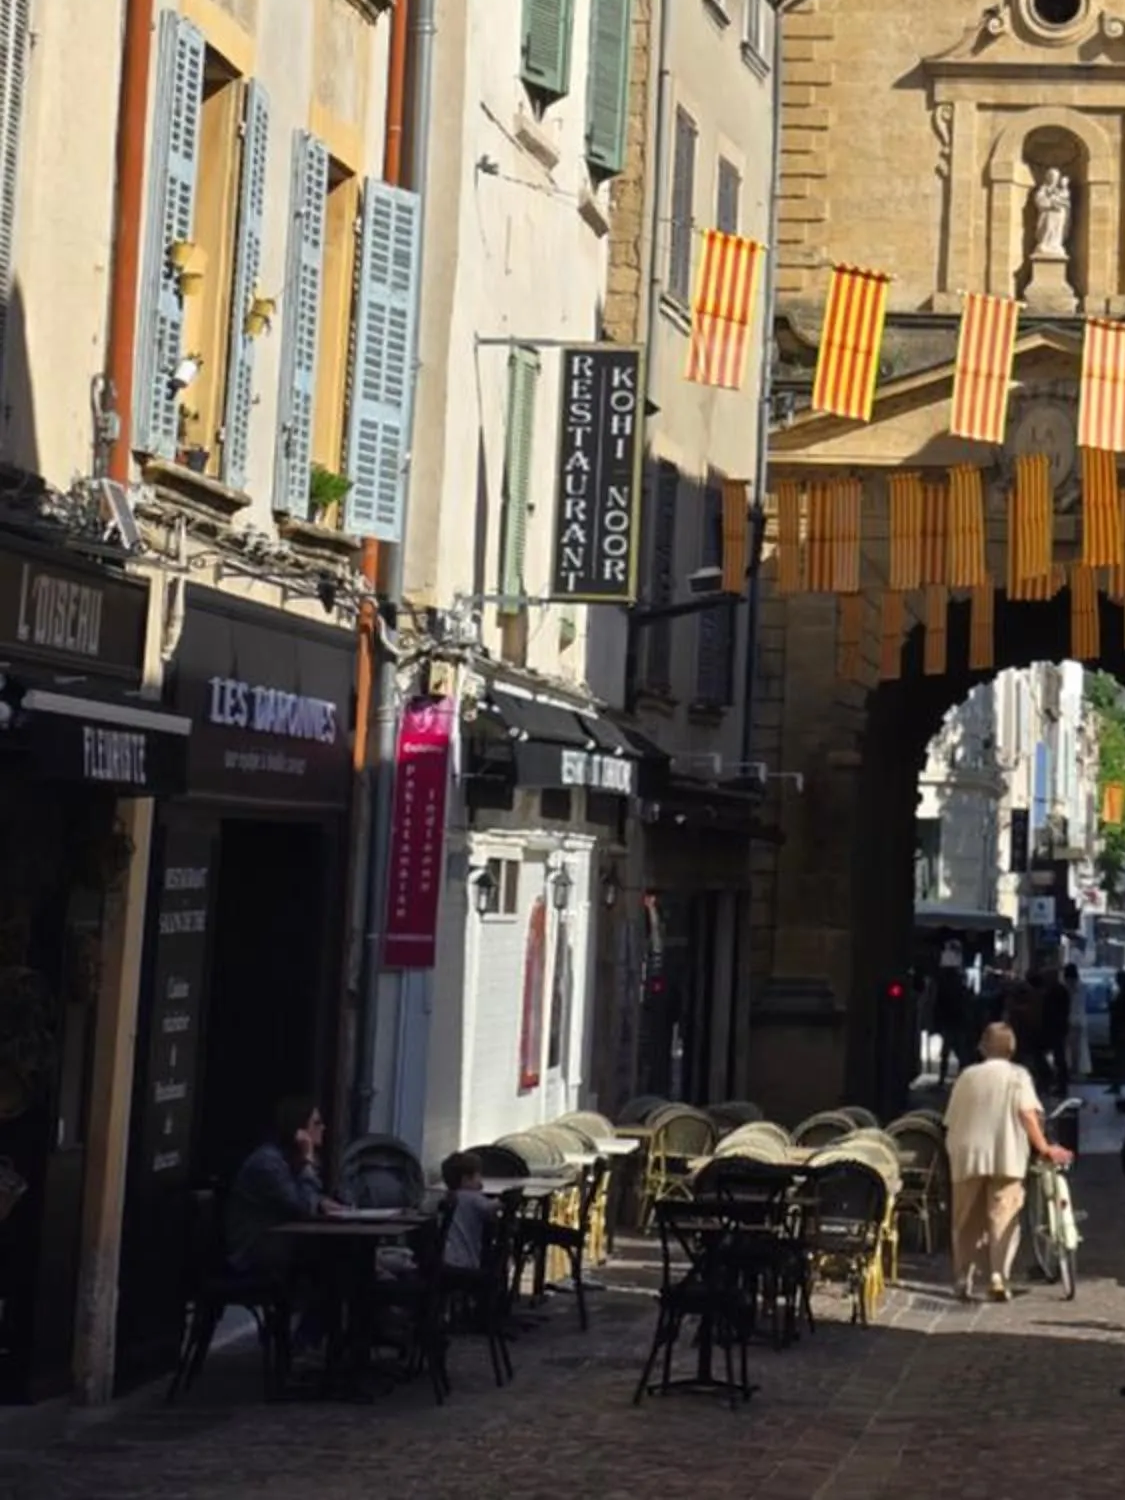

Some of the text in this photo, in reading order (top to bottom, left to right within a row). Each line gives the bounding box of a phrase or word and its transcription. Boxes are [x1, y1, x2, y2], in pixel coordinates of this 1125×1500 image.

[560, 355, 593, 592] RESTAURANT
[603, 366, 635, 582] KOHI NOOR
[208, 676, 249, 728] LES
